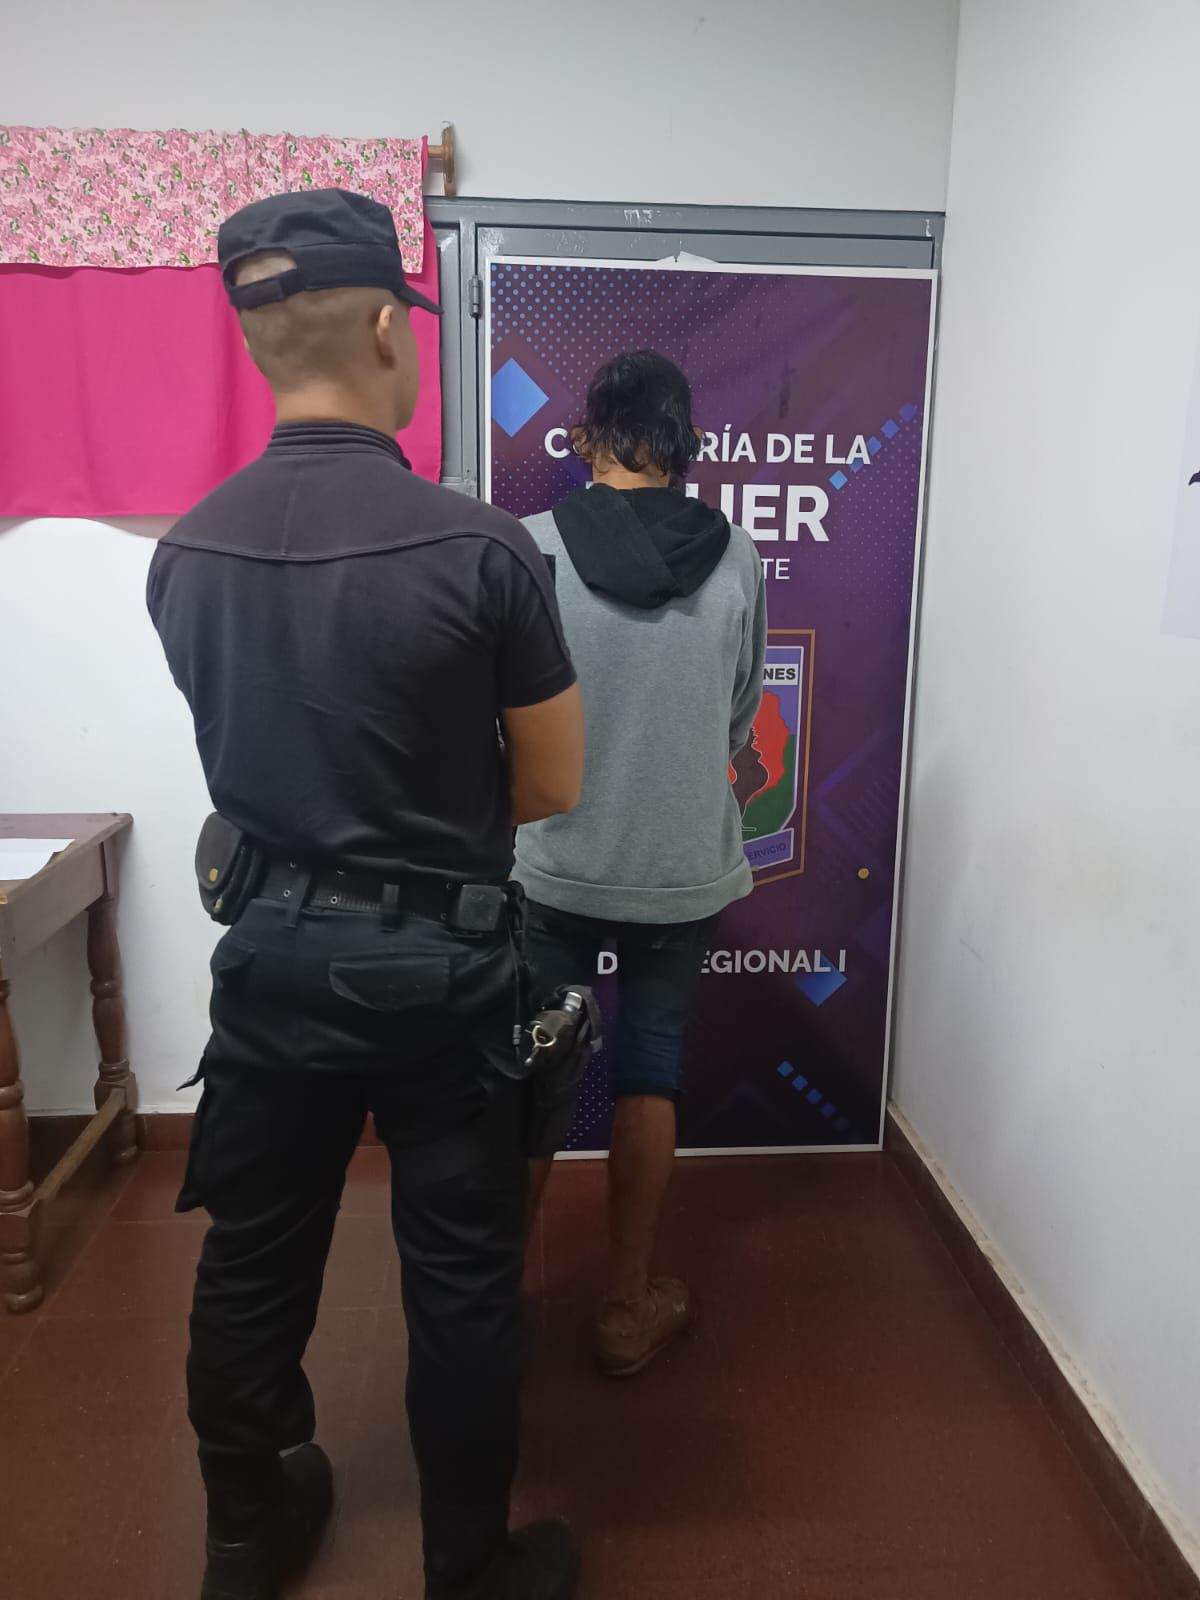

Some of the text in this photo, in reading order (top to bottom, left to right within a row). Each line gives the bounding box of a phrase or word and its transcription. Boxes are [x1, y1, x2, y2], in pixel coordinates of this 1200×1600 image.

[766, 433, 815, 464] DE
[825, 434, 871, 465] LA
[763, 667, 796, 680] NES
